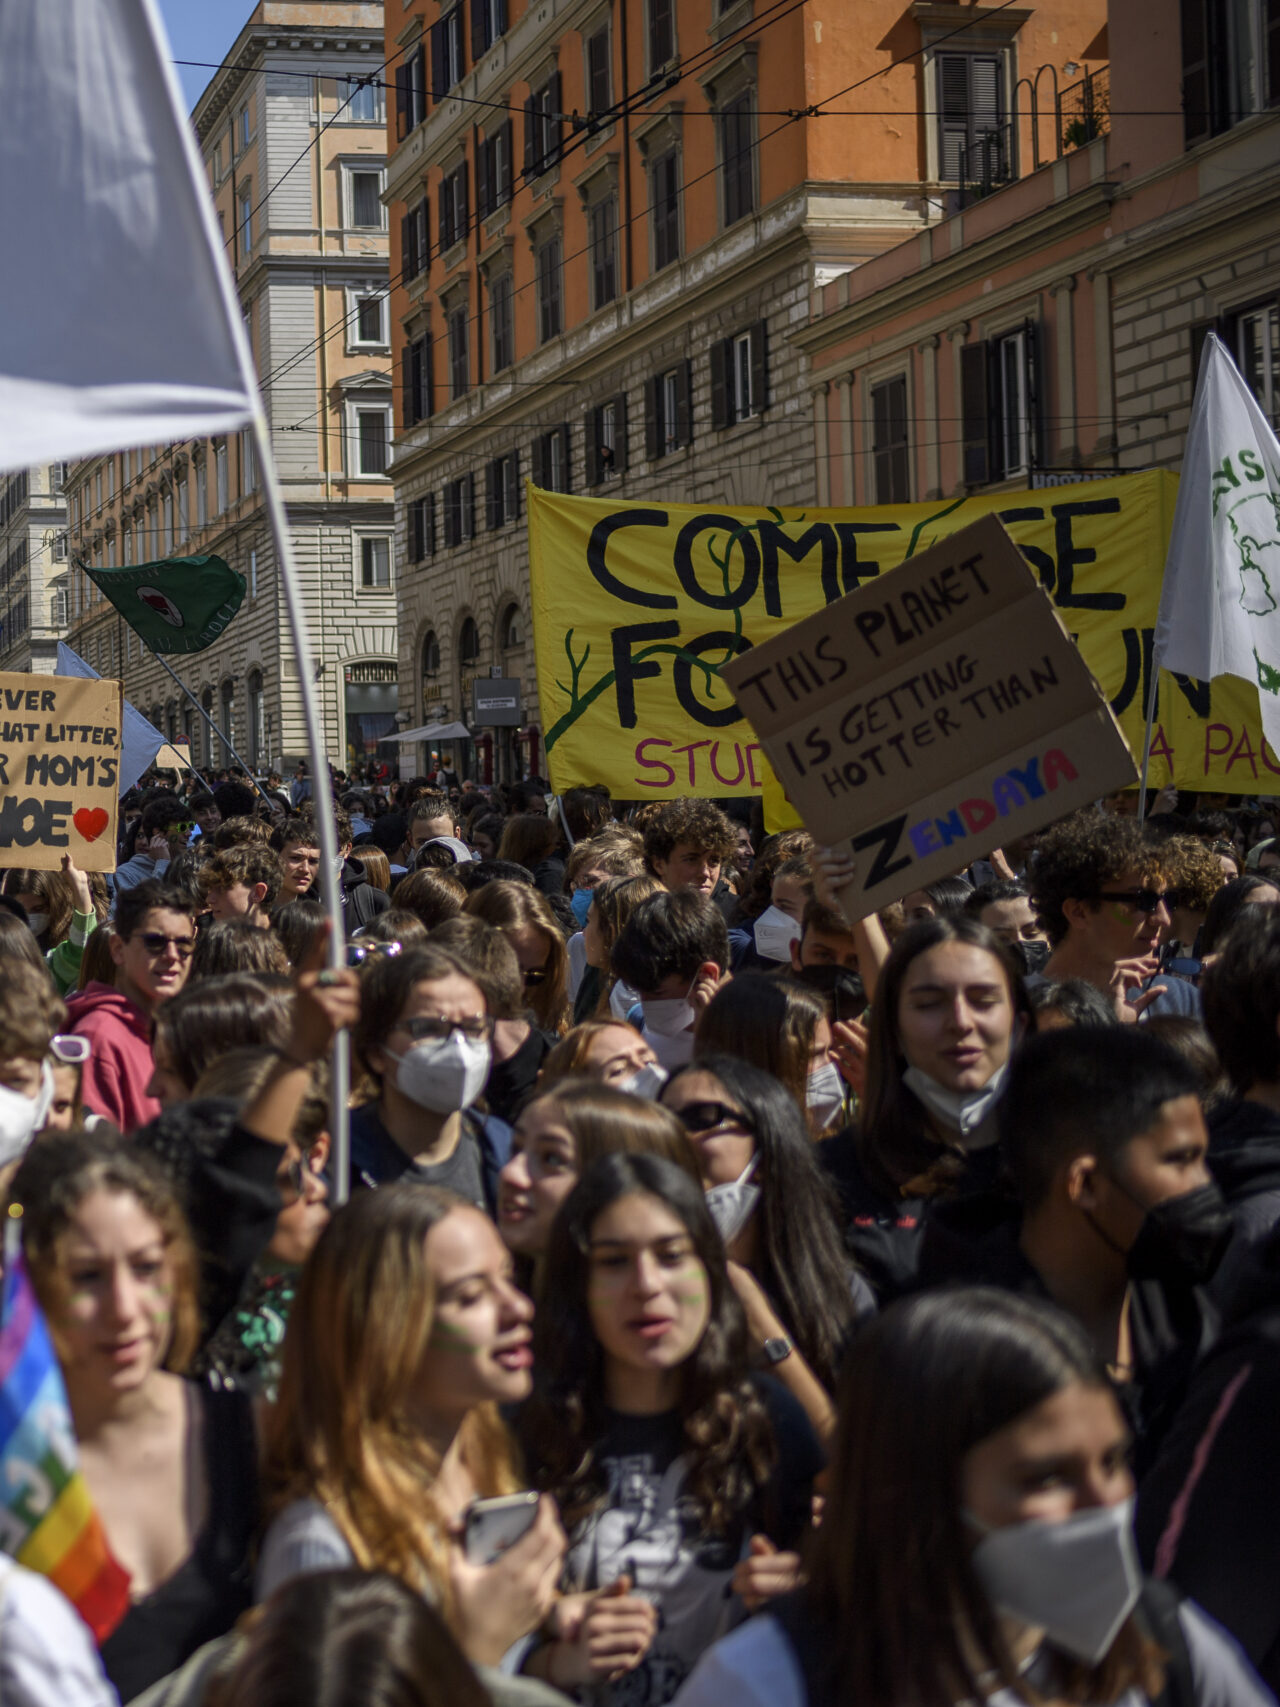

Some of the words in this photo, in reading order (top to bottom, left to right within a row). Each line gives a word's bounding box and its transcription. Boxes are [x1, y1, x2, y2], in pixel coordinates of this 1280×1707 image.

[737, 632, 849, 716] THIS
[854, 553, 992, 659] PLANET
[25, 753, 118, 788] MOM'S
[45, 722, 119, 750] LITTER,
[784, 726, 832, 777] IS
[839, 653, 979, 746] GETTING
[821, 705, 962, 799] HOTTER
[960, 655, 1060, 721] THAN
[851, 747, 1080, 891] ZENDAYA
